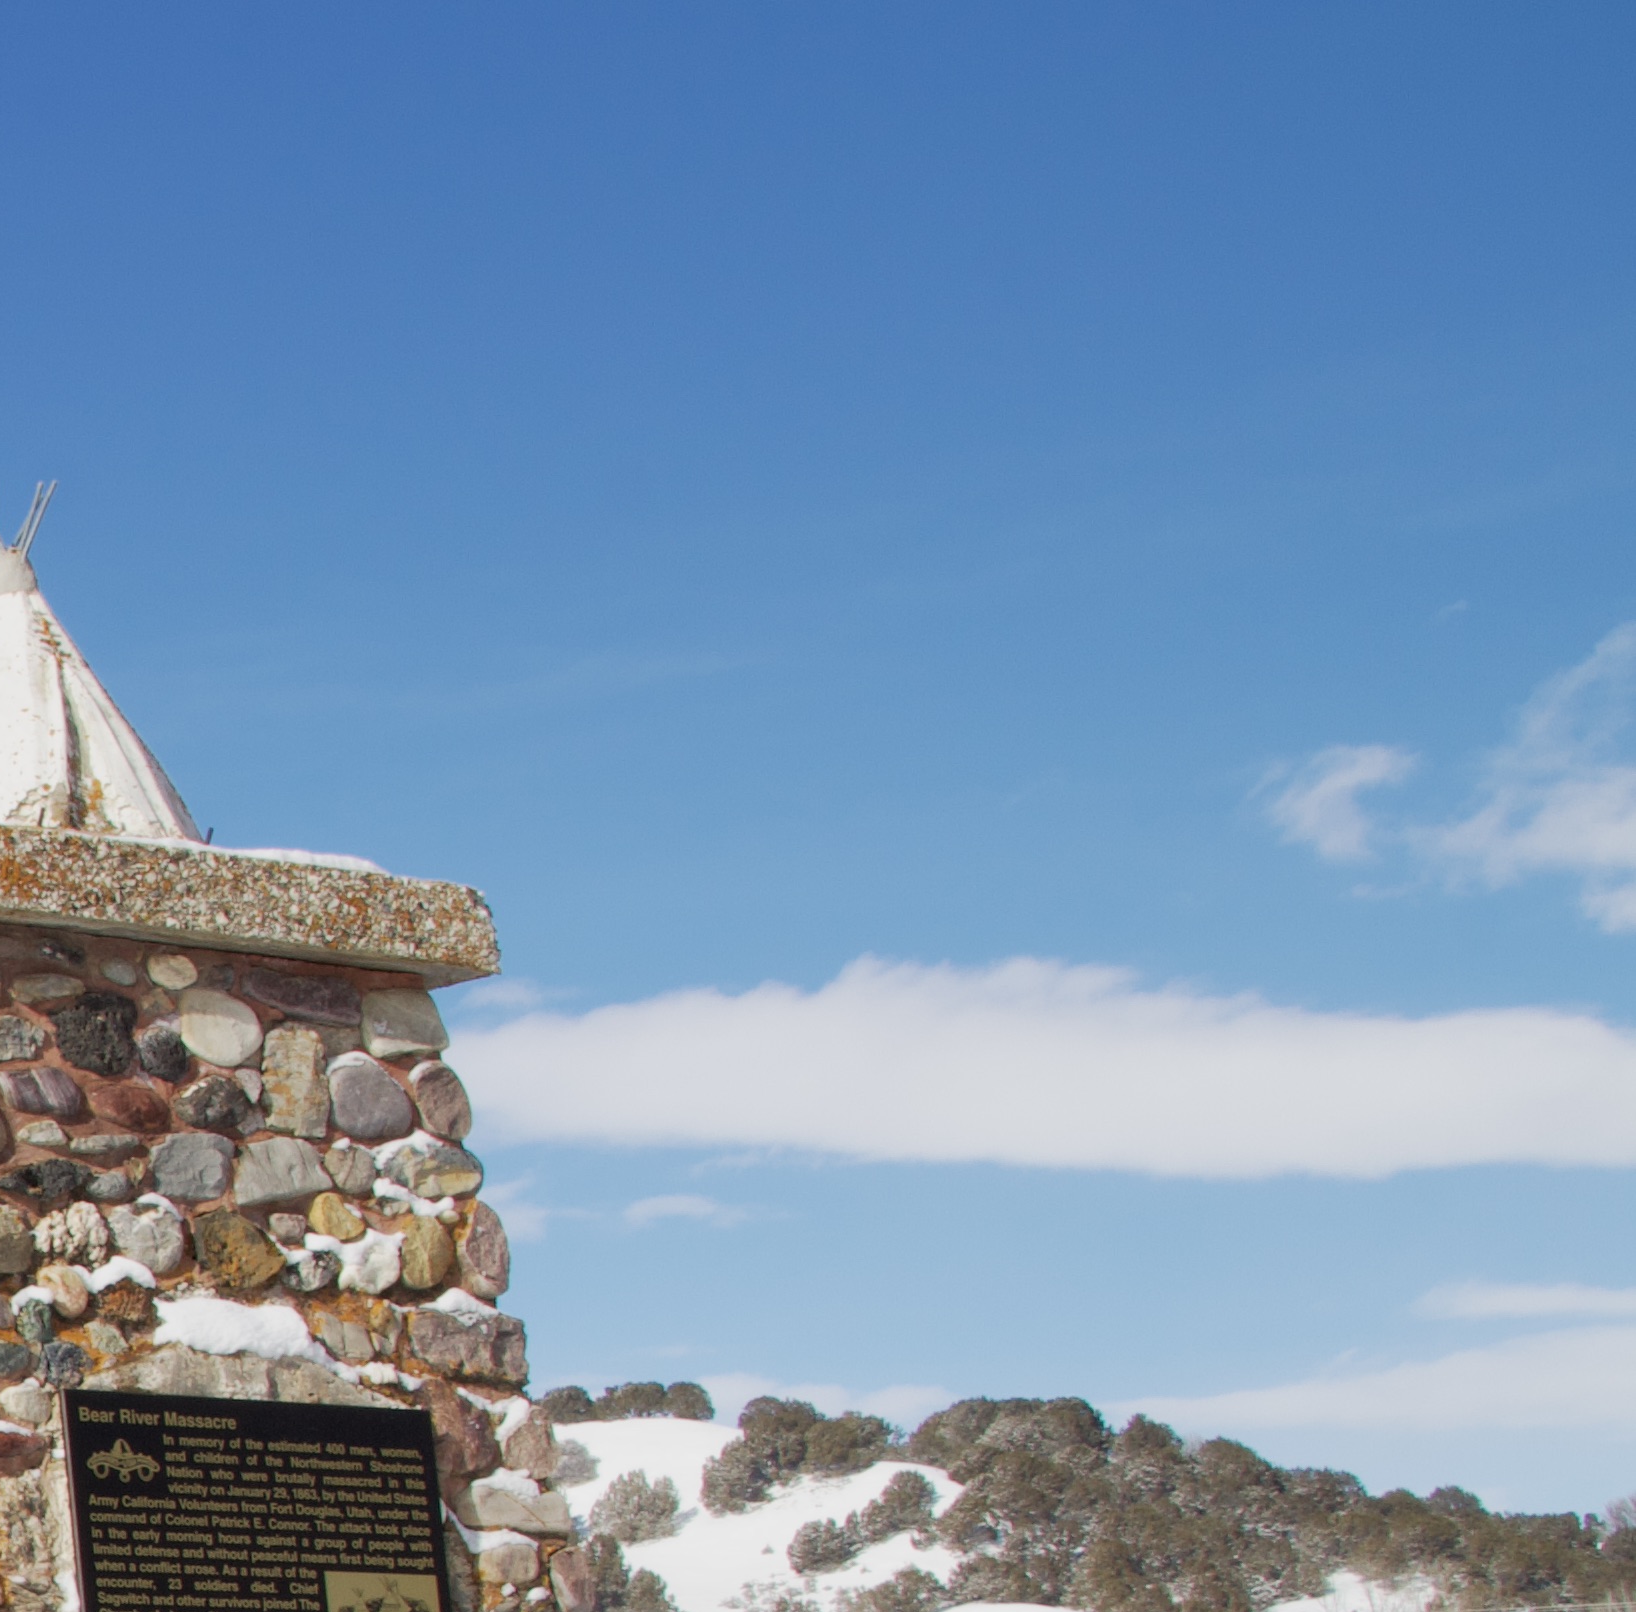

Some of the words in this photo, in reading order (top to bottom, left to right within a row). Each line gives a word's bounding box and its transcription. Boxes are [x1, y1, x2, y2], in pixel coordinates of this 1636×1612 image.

[78, 1406, 115, 1423] Bear
[119, 1408, 160, 1425] River
[164, 1411, 236, 1429] Massacre
[162, 1434, 174, 1445] In
[178, 1437, 225, 1451] memory
[228, 1437, 241, 1449] of
[244, 1438, 263, 1450] the
[267, 1439, 321, 1453] estimated
[349, 1446, 376, 1457] men,
[380, 1448, 422, 1459] women,
[164, 1450, 186, 1462] and
[193, 1451, 239, 1464] children
[245, 1454, 258, 1465] of
[264, 1455, 283, 1467] the
[290, 1456, 363, 1471] Northwestern
[166, 1465, 203, 1478] Nation
[209, 1468, 234, 1480] who
[241, 1472, 268, 1481] were
[274, 1471, 316, 1486] brutally
[322, 1474, 382, 1487] massacred
[388, 1477, 399, 1488] in
[405, 1477, 426, 1489] this
[167, 1481, 208, 1497] vicinity
[209, 1486, 225, 1495] on
[226, 1484, 272, 1500] January
[321, 1489, 336, 1503] by
[337, 1490, 355, 1501] the
[356, 1491, 392, 1503] United
[393, 1492, 427, 1505] States
[88, 1494, 119, 1509] Army
[121, 1495, 176, 1509] California
[178, 1498, 238, 1512] Volunteers
[240, 1501, 267, 1513] from
[269, 1502, 293, 1514] Fort
[295, 1503, 344, 1519] Douglas,
[346, 1506, 375, 1519] Utah,
[377, 1507, 409, 1519] under
[411, 1509, 429, 1521] the
[89, 1510, 146, 1523] command
[149, 1512, 162, 1524] of
[164, 1513, 208, 1526] Colonel
[211, 1515, 250, 1528] Patrick
[253, 1517, 265, 1529] E.
[268, 1517, 311, 1531] Connor.
[314, 1520, 336, 1532] The
[338, 1521, 372, 1533] attack
[374, 1523, 399, 1535] took
[401, 1524, 431, 1538] place
[91, 1526, 102, 1538] in
[108, 1527, 127, 1539] the
[132, 1528, 160, 1543] early
[165, 1530, 213, 1545] morning
[217, 1532, 251, 1544] hours
[255, 1533, 297, 1549] against
[301, 1537, 309, 1546] a
[313, 1538, 347, 1551] group
[351, 1537, 363, 1549] of
[367, 1538, 405, 1553] people
[409, 1540, 432, 1551] with
[92, 1542, 131, 1555] limited
[134, 1544, 180, 1557] defense
[182, 1546, 204, 1558] and
[206, 1547, 248, 1560] without
[250, 1549, 298, 1564] peaceful
[300, 1553, 337, 1563] means
[339, 1553, 361, 1564] first
[363, 1554, 395, 1568] being
[396, 1555, 434, 1570] sought
[94, 1559, 125, 1571] when
[128, 1563, 136, 1571] a
[139, 1560, 181, 1573] conflict
[184, 1565, 218, 1575] arose.
[221, 1564, 237, 1575] As
[240, 1567, 247, 1576] a
[250, 1565, 282, 1577] result
[284, 1566, 296, 1578] of
[298, 1567, 317, 1578] the
[95, 1576, 156, 1589] encounter,
[167, 1578, 182, 1589] 23
[193, 1579, 239, 1591] soldiers
[249, 1581, 278, 1593] died.
[289, 1582, 319, 1594] Chief
[152, 1594, 174, 1605] and
[175, 1594, 206, 1606] other
[208, 1595, 260, 1608] survivors
[262, 1597, 297, 1612] joined
[298, 1598, 320, 1610] The
